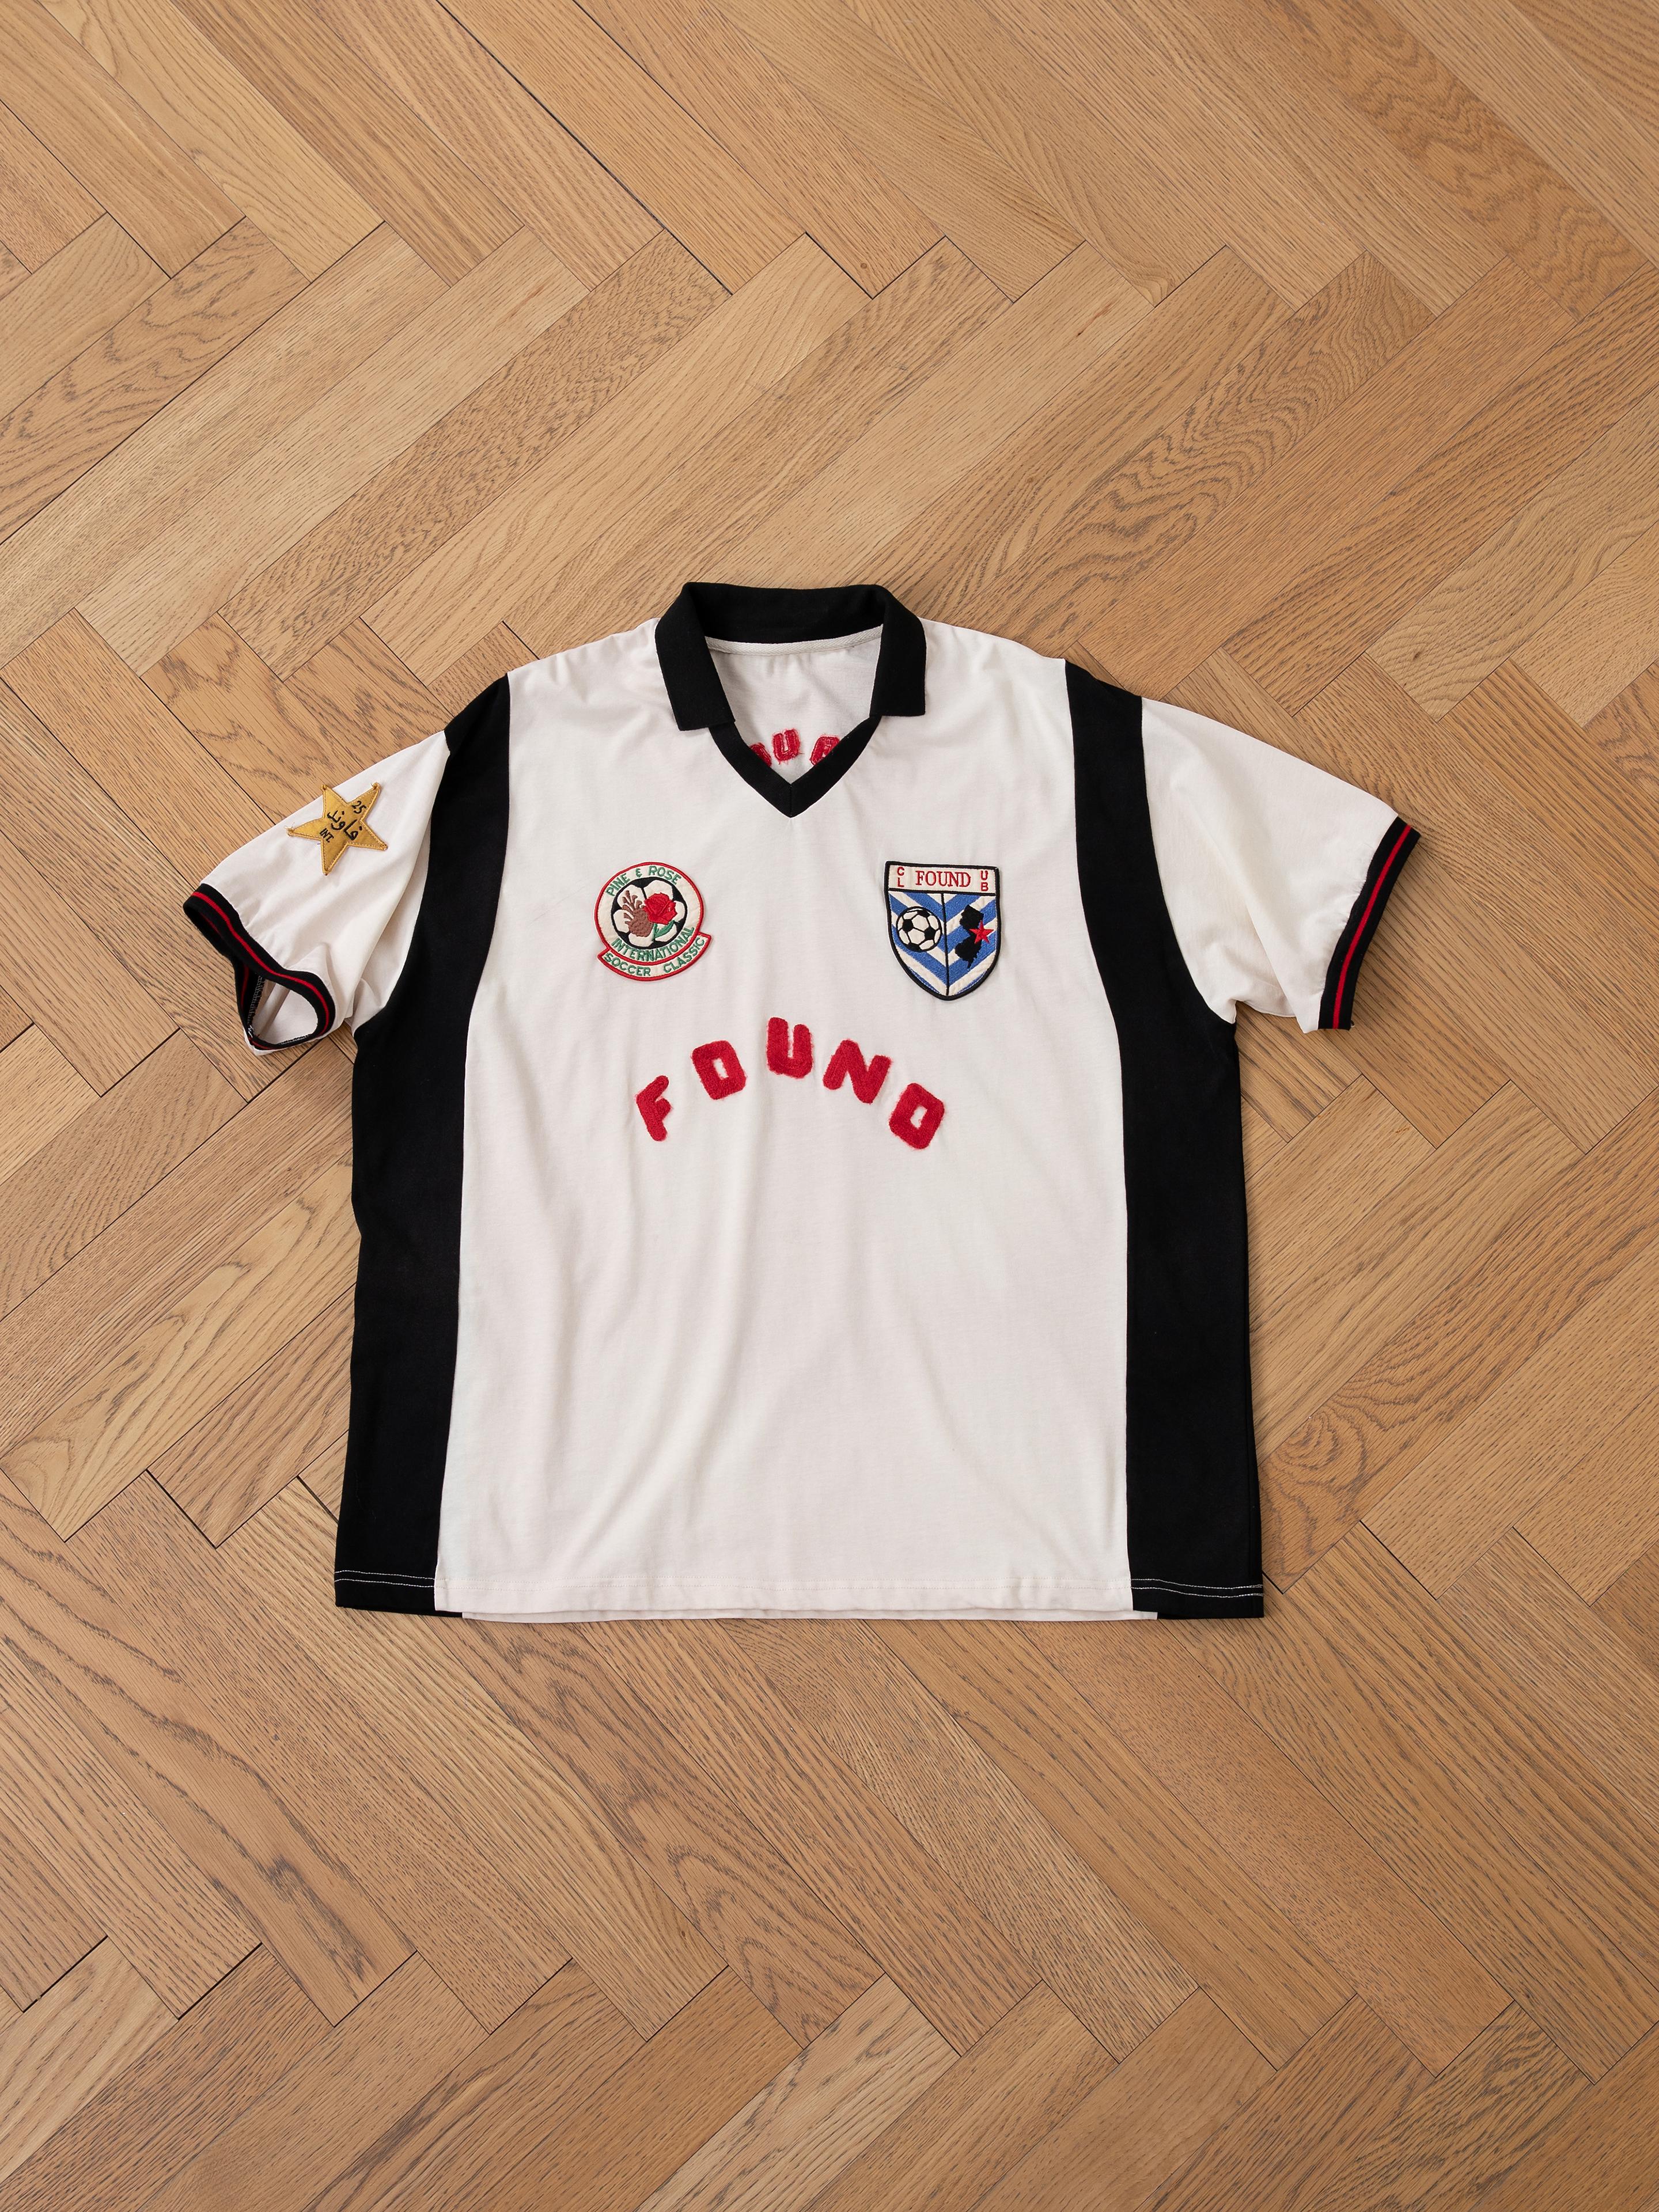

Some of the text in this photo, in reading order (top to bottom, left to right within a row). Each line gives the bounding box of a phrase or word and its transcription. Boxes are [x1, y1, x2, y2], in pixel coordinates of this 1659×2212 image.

[351, 800, 366, 814] 25
[605, 866, 681, 896] PINE & ROSE
[915, 870, 971, 887] FOUND
[604, 937, 704, 976] SOCCER CLASSIC
[611, 927, 695, 962] INTERNATIONAL
[635, 1017, 945, 1149] FOUND
